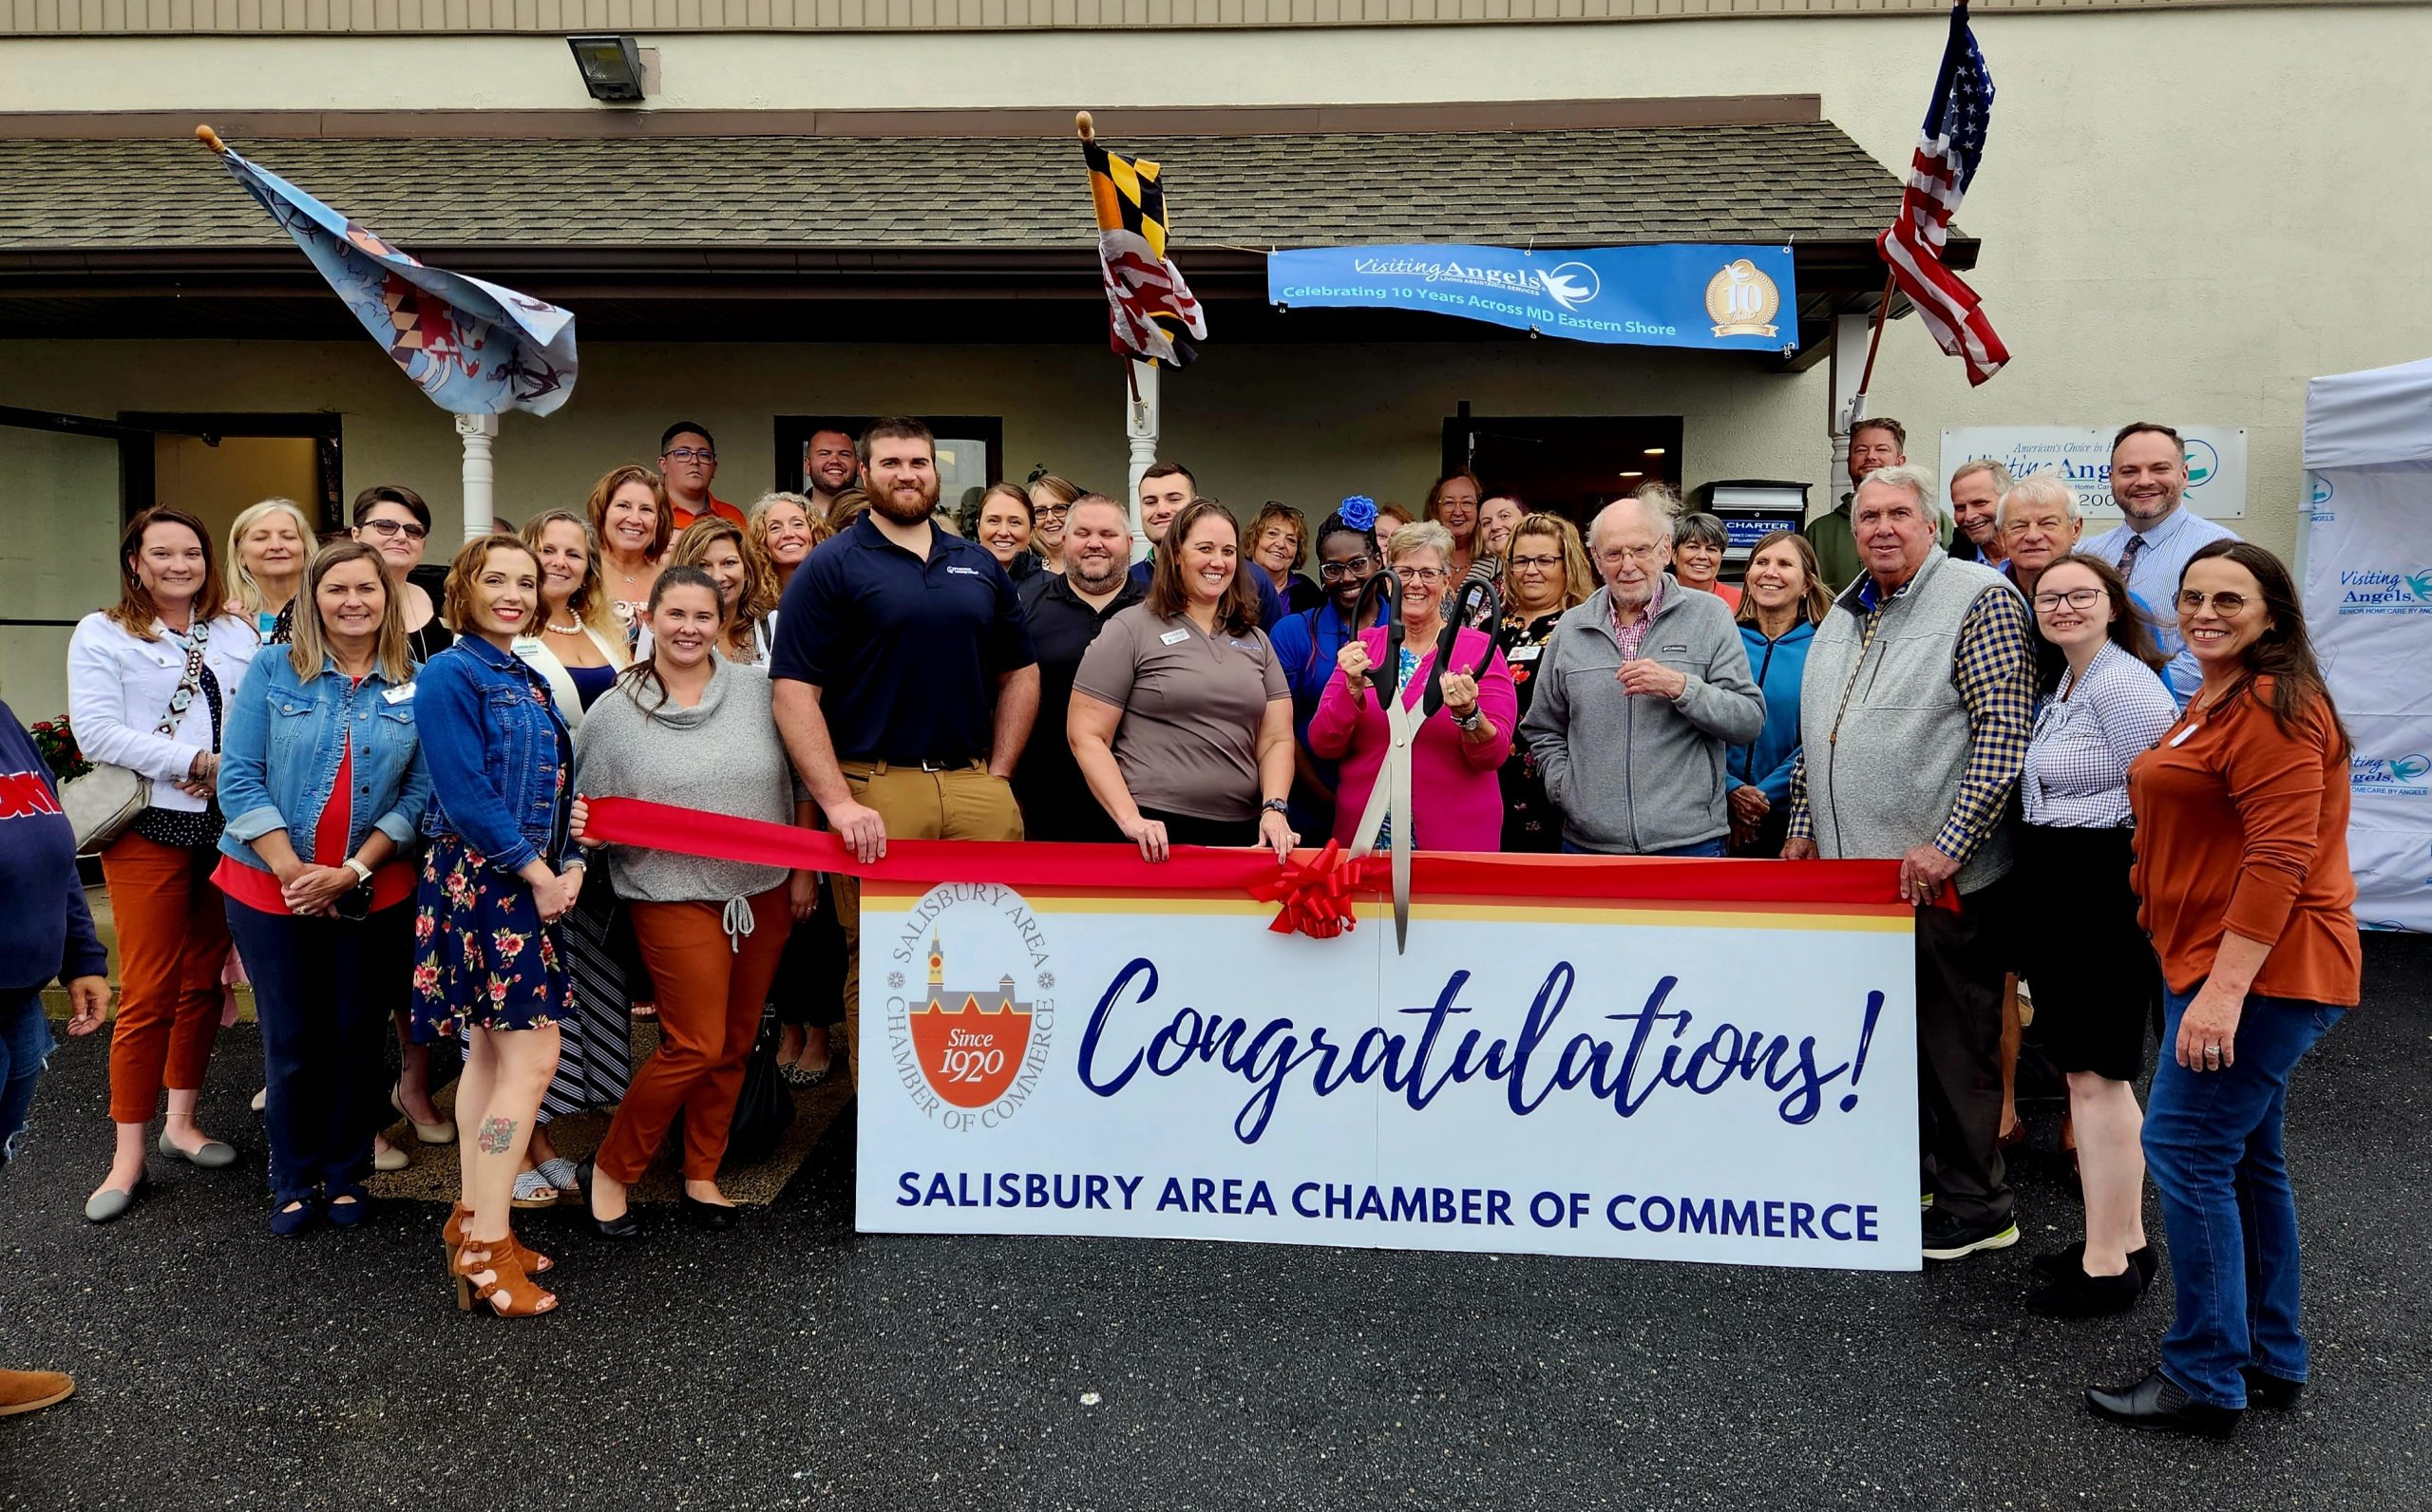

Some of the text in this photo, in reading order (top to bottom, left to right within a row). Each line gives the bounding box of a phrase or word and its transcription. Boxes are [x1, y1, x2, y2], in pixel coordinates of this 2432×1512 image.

[1355, 258, 1541, 289] Visiting Angels
[1464, 278, 1506, 290] ASSISTANCE
[1508, 285, 1540, 296] SERVICES
[1282, 286, 1677, 335] Celebrating 10 Years Across MD Eastern Shore
[1723, 283, 1763, 314] 10
[2013, 443, 2061, 453] American's
[2063, 442, 2091, 453] Choice
[2093, 443, 2103, 453] in
[1726, 521, 1789, 530] CHARTER
[2340, 570, 2401, 592] Visiting
[893, 881, 1050, 970] SALISBURY AREA
[947, 1029, 994, 1048] Since
[1077, 957, 1886, 1144] Congratulations!
[886, 995, 1054, 1133] CHAMBER OF COMMERCE
[938, 1049, 1004, 1083] 1920
[895, 1171, 1880, 1242] SALISBURY AREA CHAMBER OF COMMERCE
